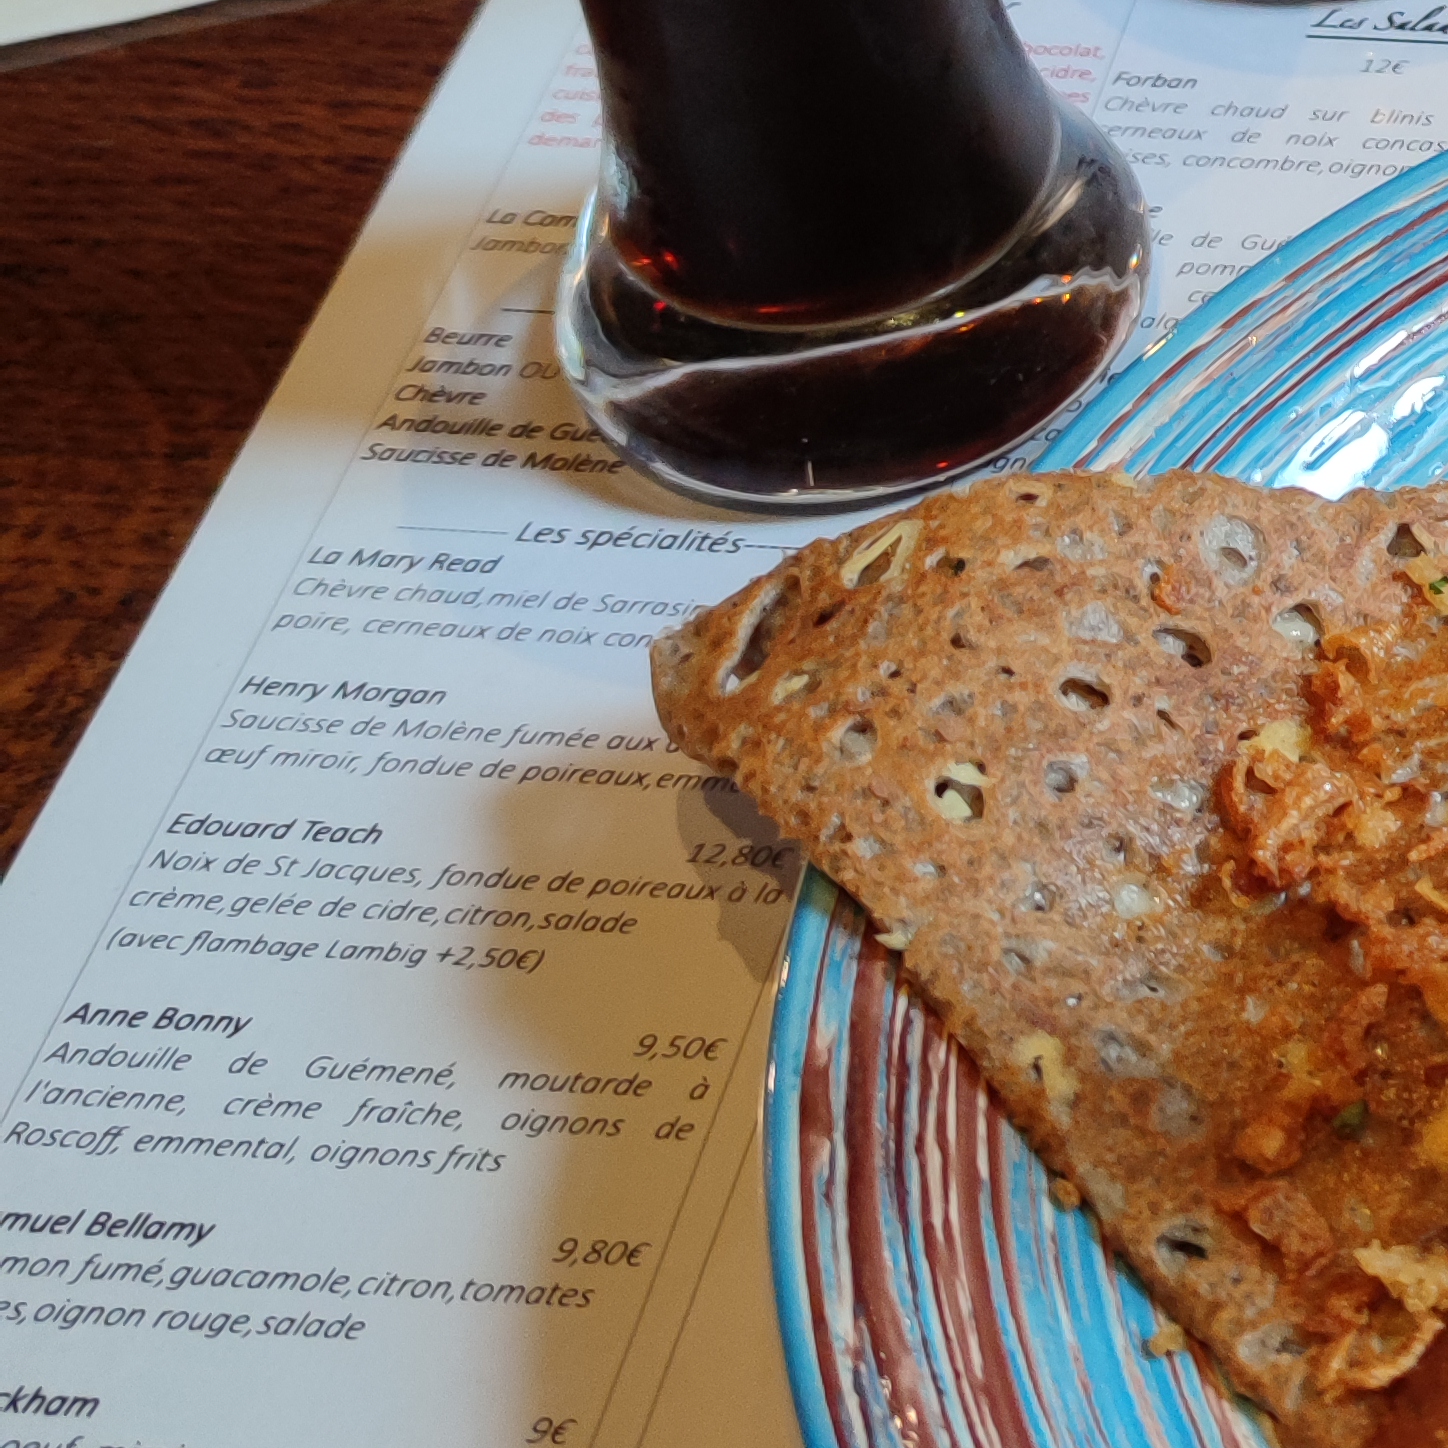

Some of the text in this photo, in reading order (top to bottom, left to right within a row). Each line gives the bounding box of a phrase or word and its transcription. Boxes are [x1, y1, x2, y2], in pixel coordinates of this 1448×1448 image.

[1310, 10, 1368, 29] Les
[1113, 72, 1197, 89] Forban
[1361, 59, 1409, 74] 12€
[360, 443, 626, 474] Saucisse de Molène
[515, 522, 745, 553] Les spécialités
[307, 547, 504, 573] La Mary Read
[239, 676, 446, 707] Henry Morgan
[221, 709, 658, 751] Saucisse de Molène fumée aux
[167, 813, 382, 844] Edouard Teach
[686, 843, 794, 868] 12,80€
[149, 850, 218, 871] Noix
[223, 853, 261, 874] de
[265, 856, 299, 876] St
[427, 864, 540, 890] fondue
[547, 871, 584, 893] de
[587, 879, 721, 900] poireaux
[727, 881, 747, 902] à
[754, 883, 784, 904] la
[63, 1003, 253, 1038] Anne Bonny
[633, 1034, 727, 1061] 9,50€
[43, 1042, 192, 1071] Andouille
[229, 1051, 268, 1075] de
[498, 1072, 652, 1097] moutarde
[689, 1076, 710, 1100] à
[311, 1140, 436, 1169] oignons
[434, 1145, 506, 1174] frits
[85, 1212, 652, 1267] Bellamy 9,80€
